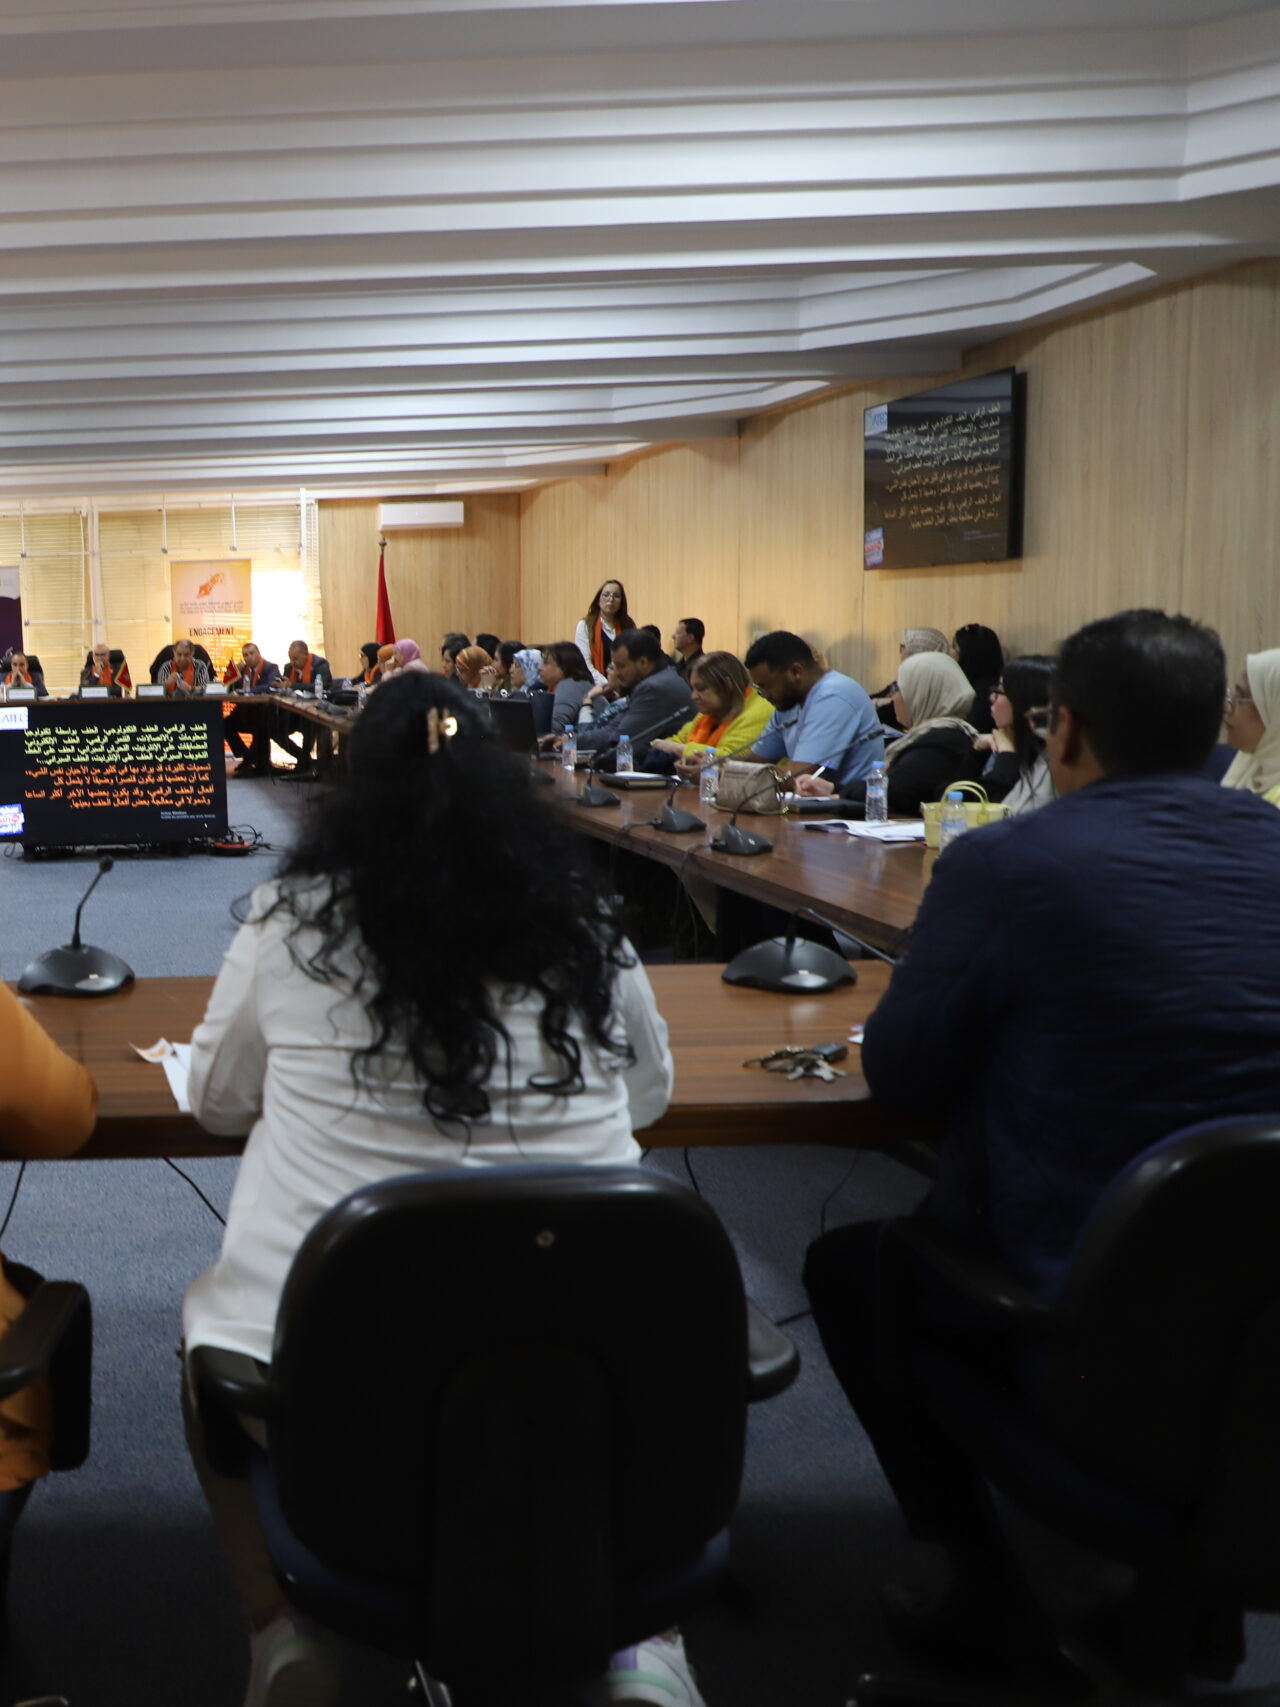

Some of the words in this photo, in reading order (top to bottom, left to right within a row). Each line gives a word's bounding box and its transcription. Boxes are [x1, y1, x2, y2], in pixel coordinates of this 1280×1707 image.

[81, 726, 98, 735] العنف
[141, 725, 158, 733] العنف
[190, 723, 207, 732] العنف
[63, 737, 80, 745] العنف
[58, 745, 74, 754] العنف
[73, 755, 89, 763] العنف
[136, 753, 153, 761] العنف
[175, 786, 194, 795] العنف
[93, 798, 111, 807] العنف
